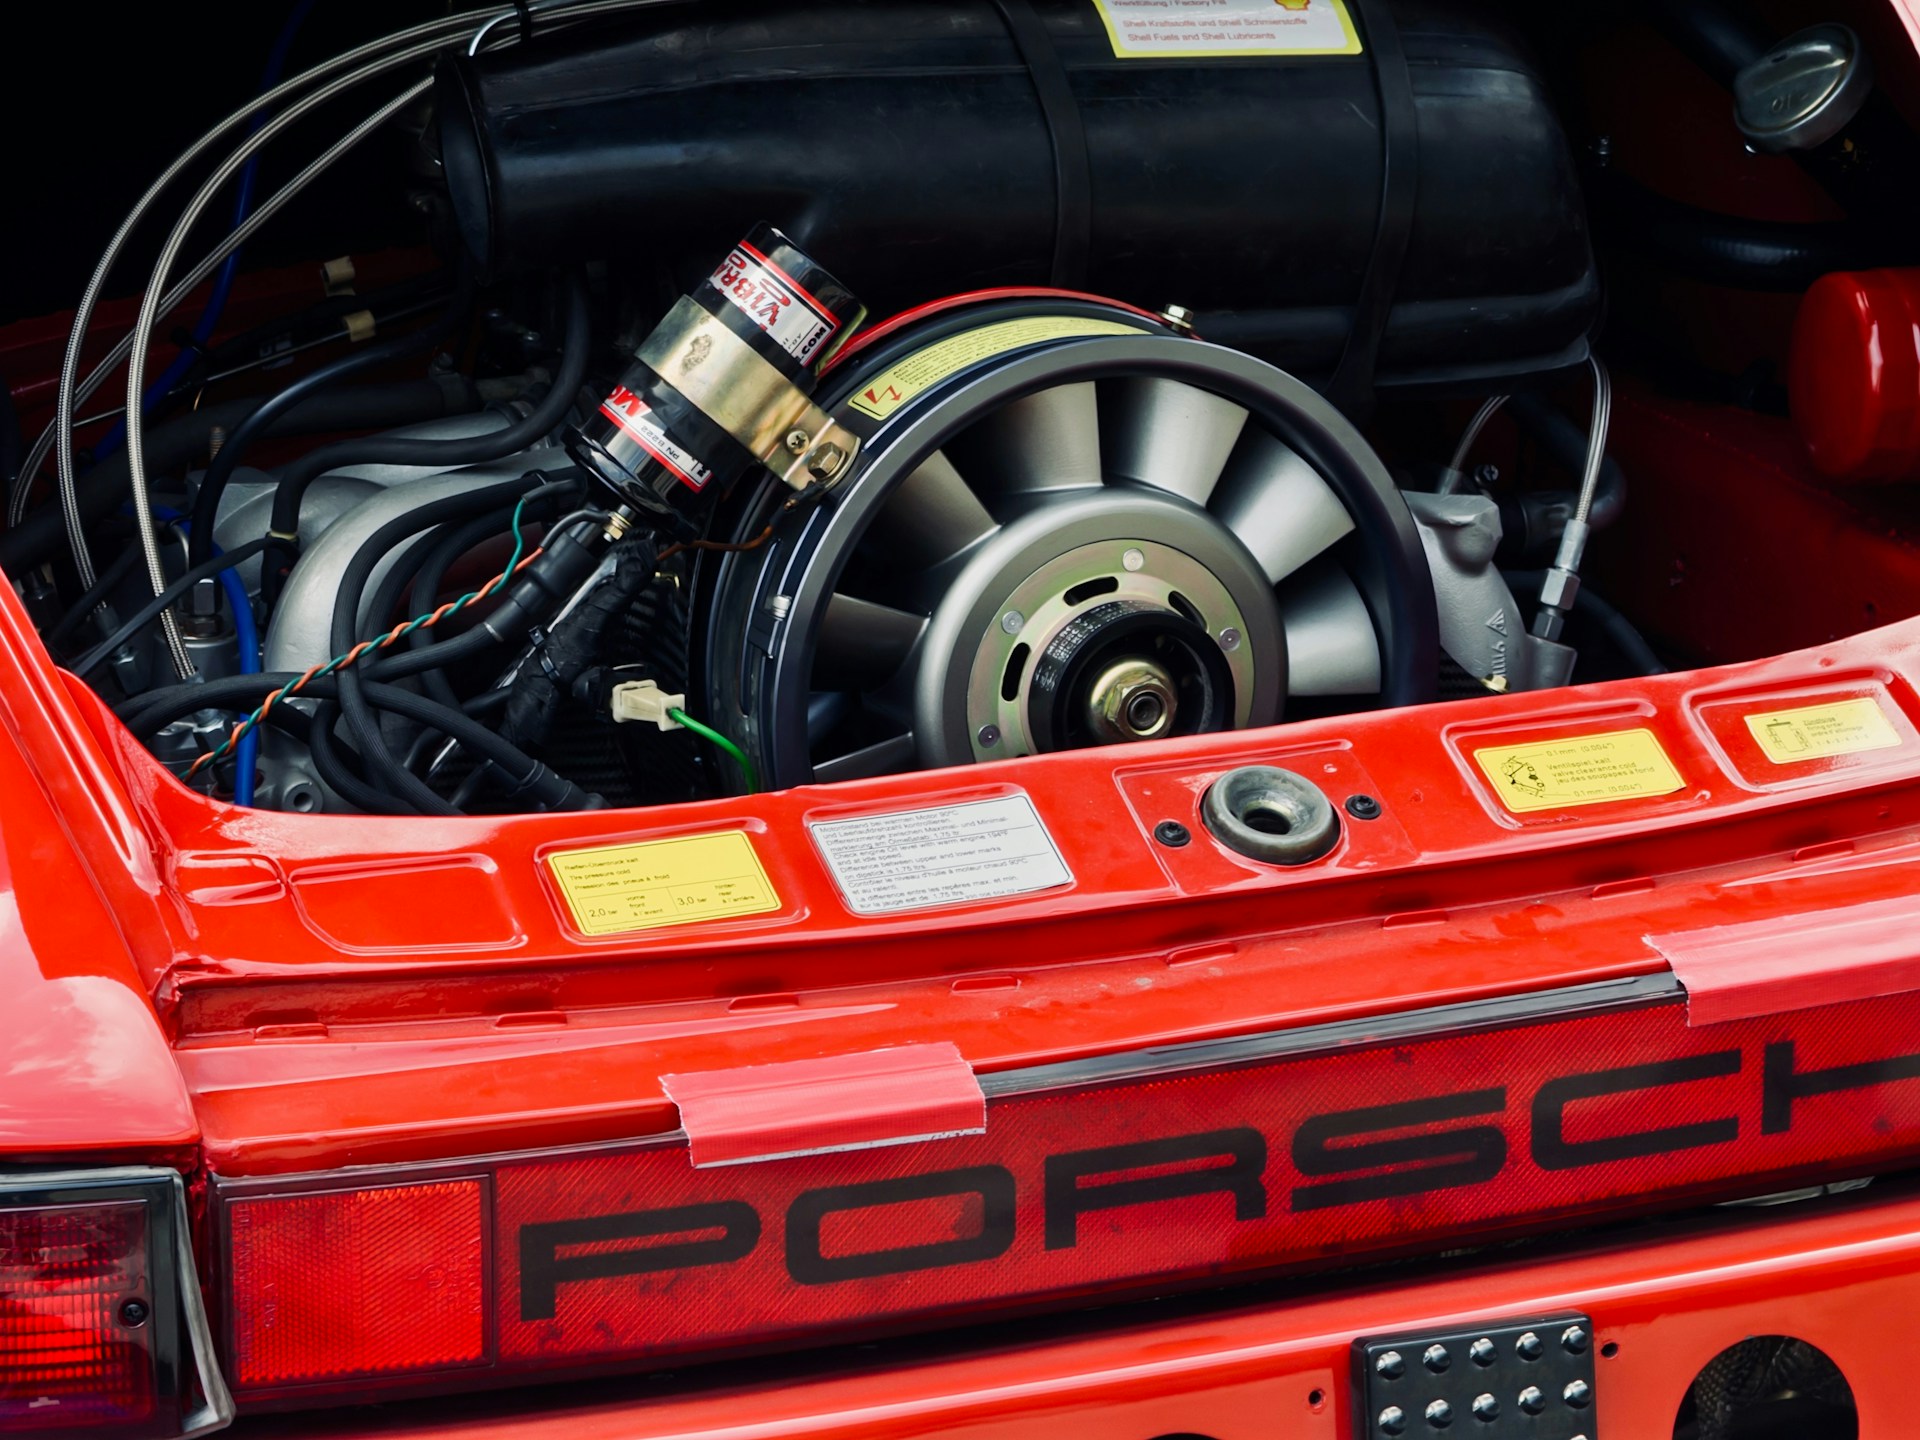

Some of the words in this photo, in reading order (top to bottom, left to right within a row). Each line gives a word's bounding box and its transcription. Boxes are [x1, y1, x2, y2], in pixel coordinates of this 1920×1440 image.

[1123, 20, 1147, 28] Shell
[1244, 18, 1307, 26] Schmierstoffe
[665, 446, 680, 461] PN
[1576, 765, 1617, 774] clearance
[1587, 771, 1628, 780] soupapes
[840, 864, 879, 873] Difference
[881, 859, 913, 867] between
[984, 861, 1007, 869] chaud
[585, 872, 614, 880] pressure
[856, 870, 886, 881] dipstick
[677, 896, 694, 906] 3,0
[589, 908, 606, 918] 2,0
